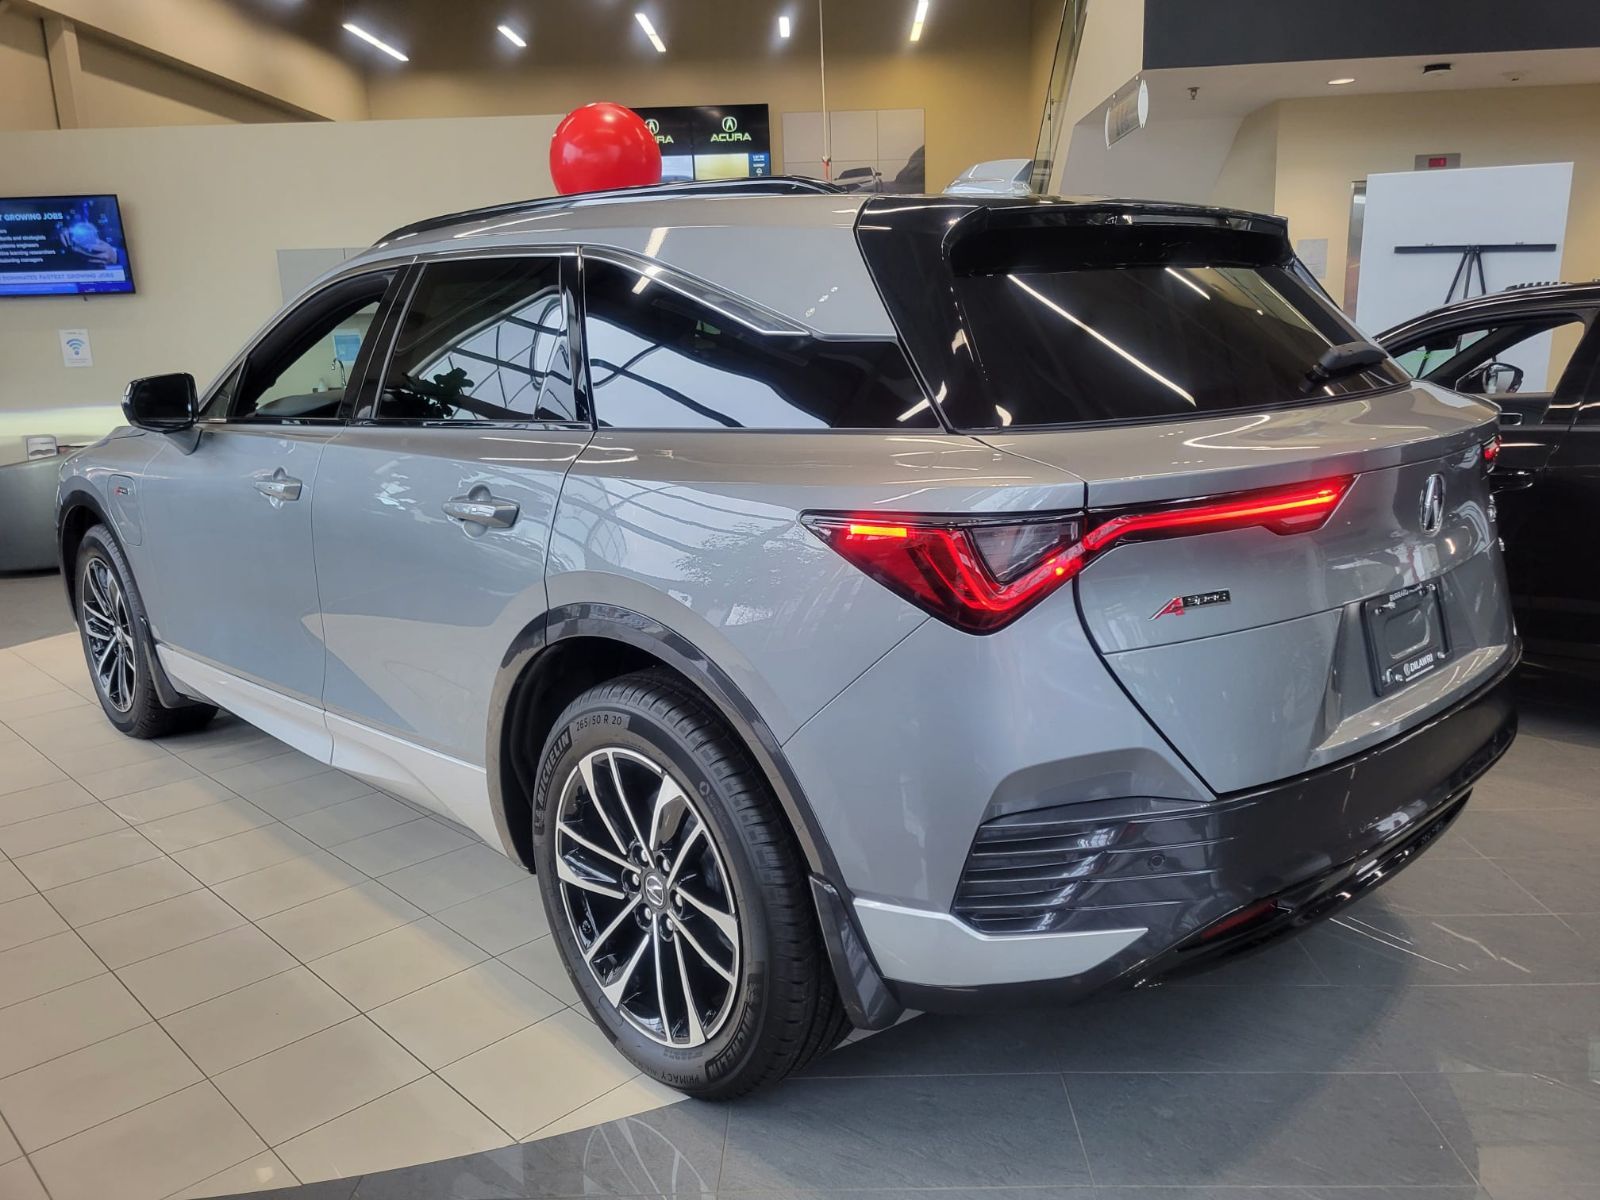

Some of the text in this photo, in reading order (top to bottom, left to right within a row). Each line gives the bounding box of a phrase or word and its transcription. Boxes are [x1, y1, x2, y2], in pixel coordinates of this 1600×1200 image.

[710, 133, 752, 142] ACURA
[4, 213, 42, 221] GROWING
[43, 212, 63, 220] JOBS
[611, 715, 622, 726] 20
[537, 733, 571, 805] MICHELIN
[660, 1071, 701, 1086] PRIMACY
